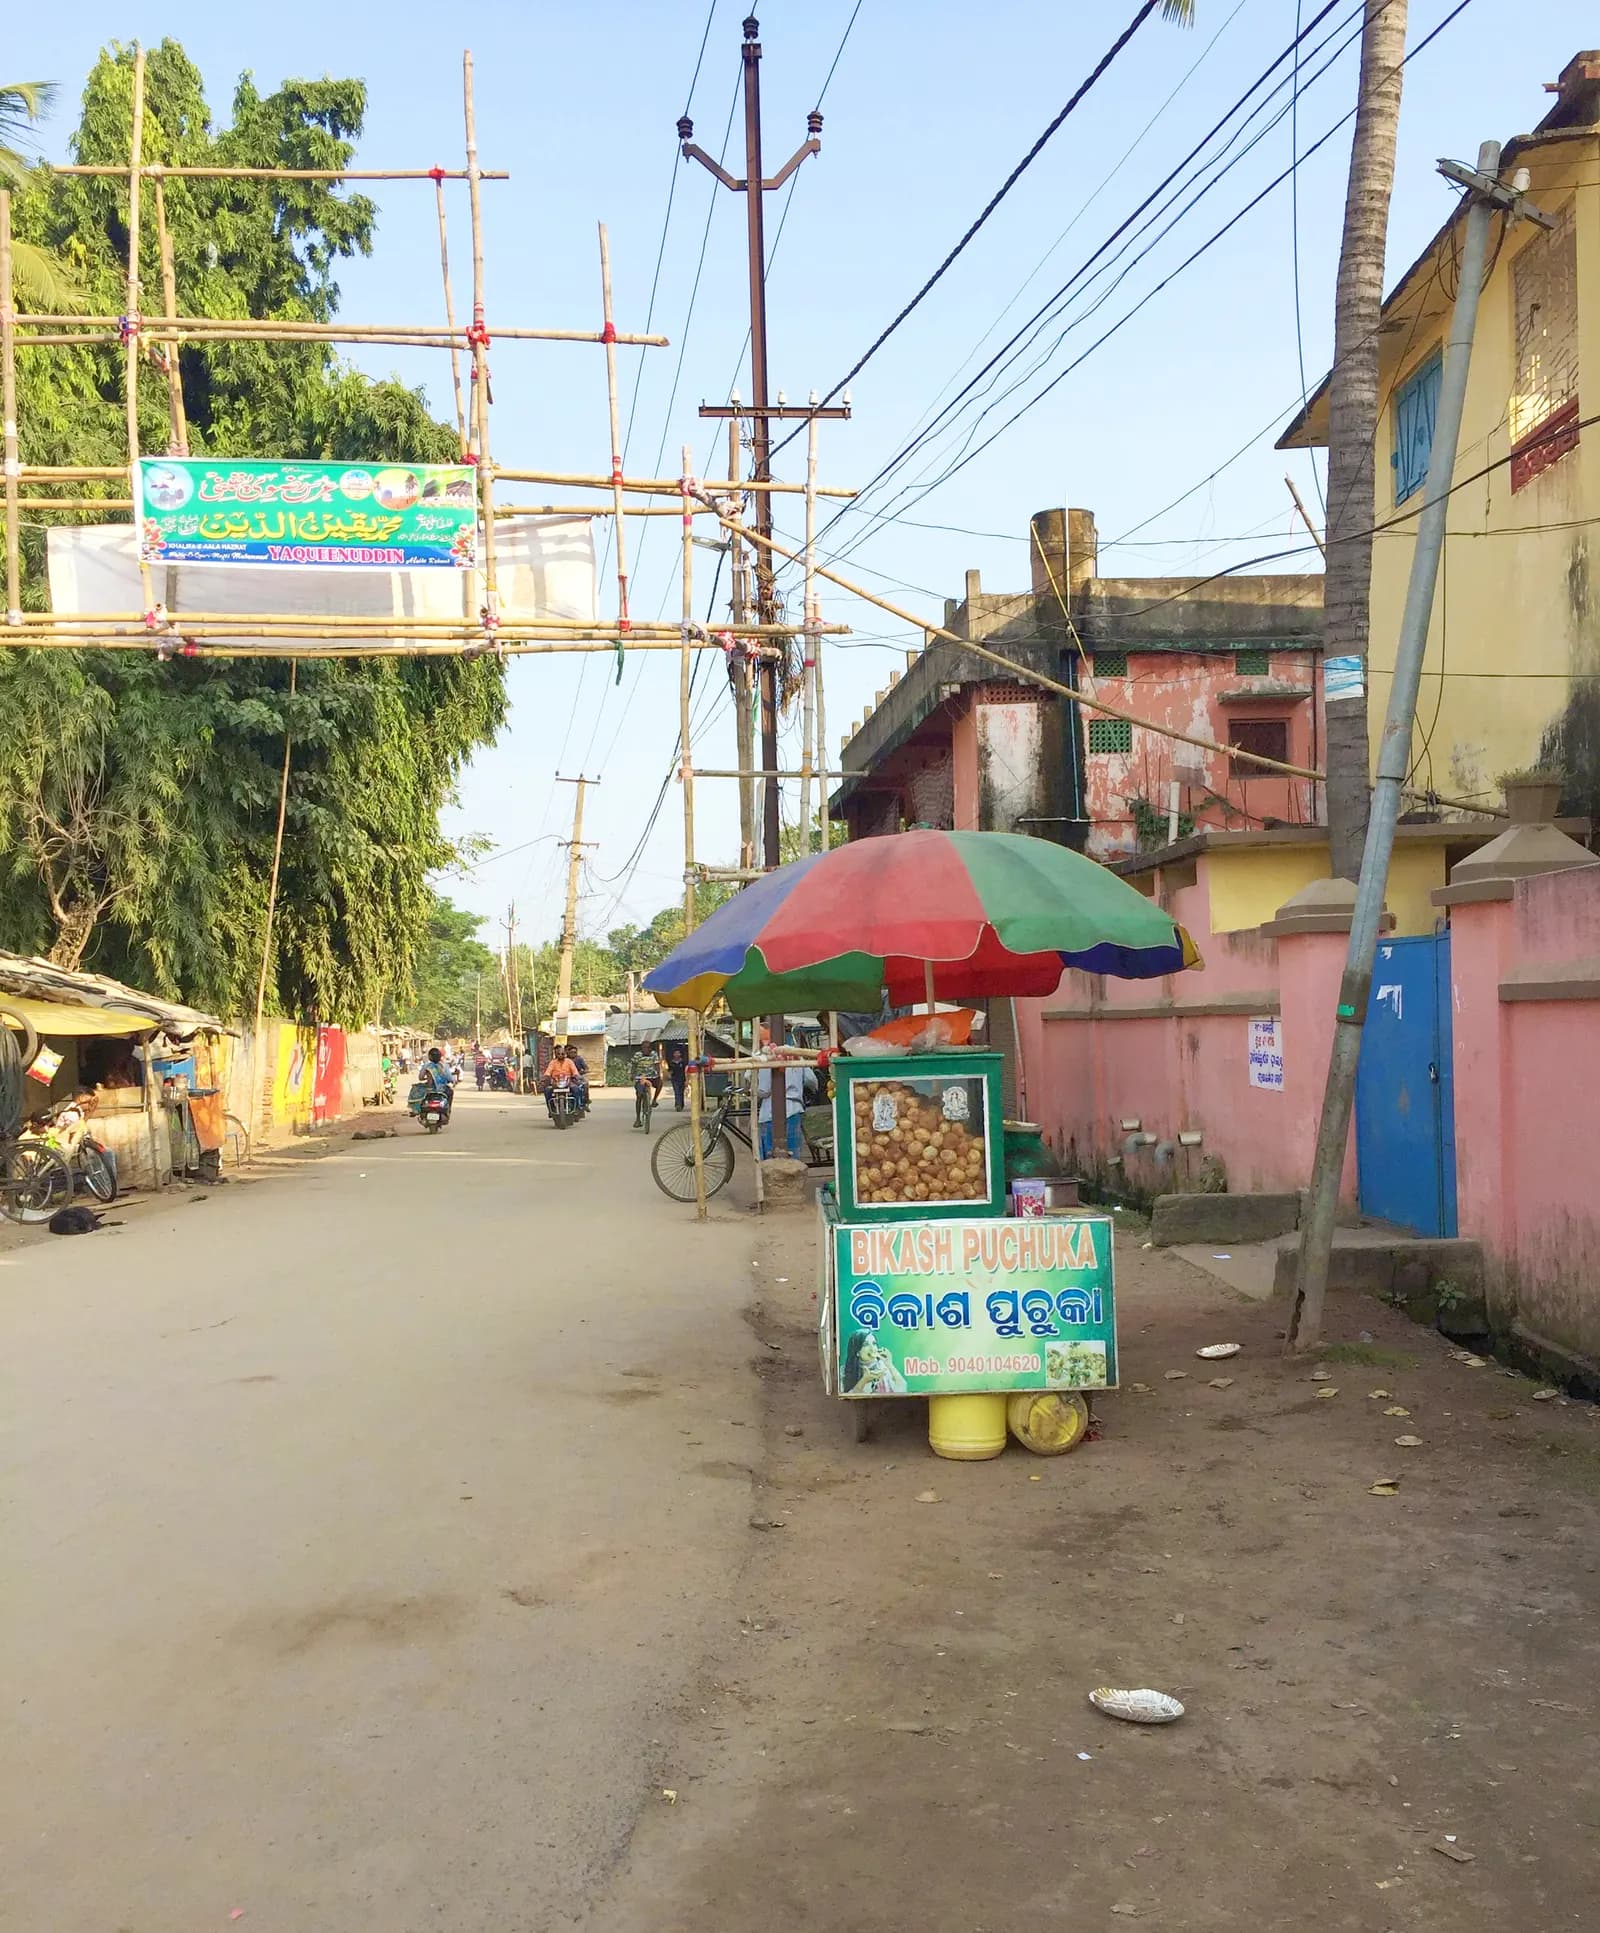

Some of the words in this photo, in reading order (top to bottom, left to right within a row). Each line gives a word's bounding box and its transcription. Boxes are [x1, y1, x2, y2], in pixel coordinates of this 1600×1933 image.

[268, 545, 404, 563] YAQUEENUDDIN
[851, 1227, 953, 1276] BIKASH
[961, 1224, 1098, 1273] PUCHUKA
[850, 1280, 972, 1330] ବିକାଶ
[985, 1287, 1104, 1338] ପୁଚୁକା
[904, 1357, 943, 1376] Mob.
[948, 1355, 1040, 1375] 9040104620
